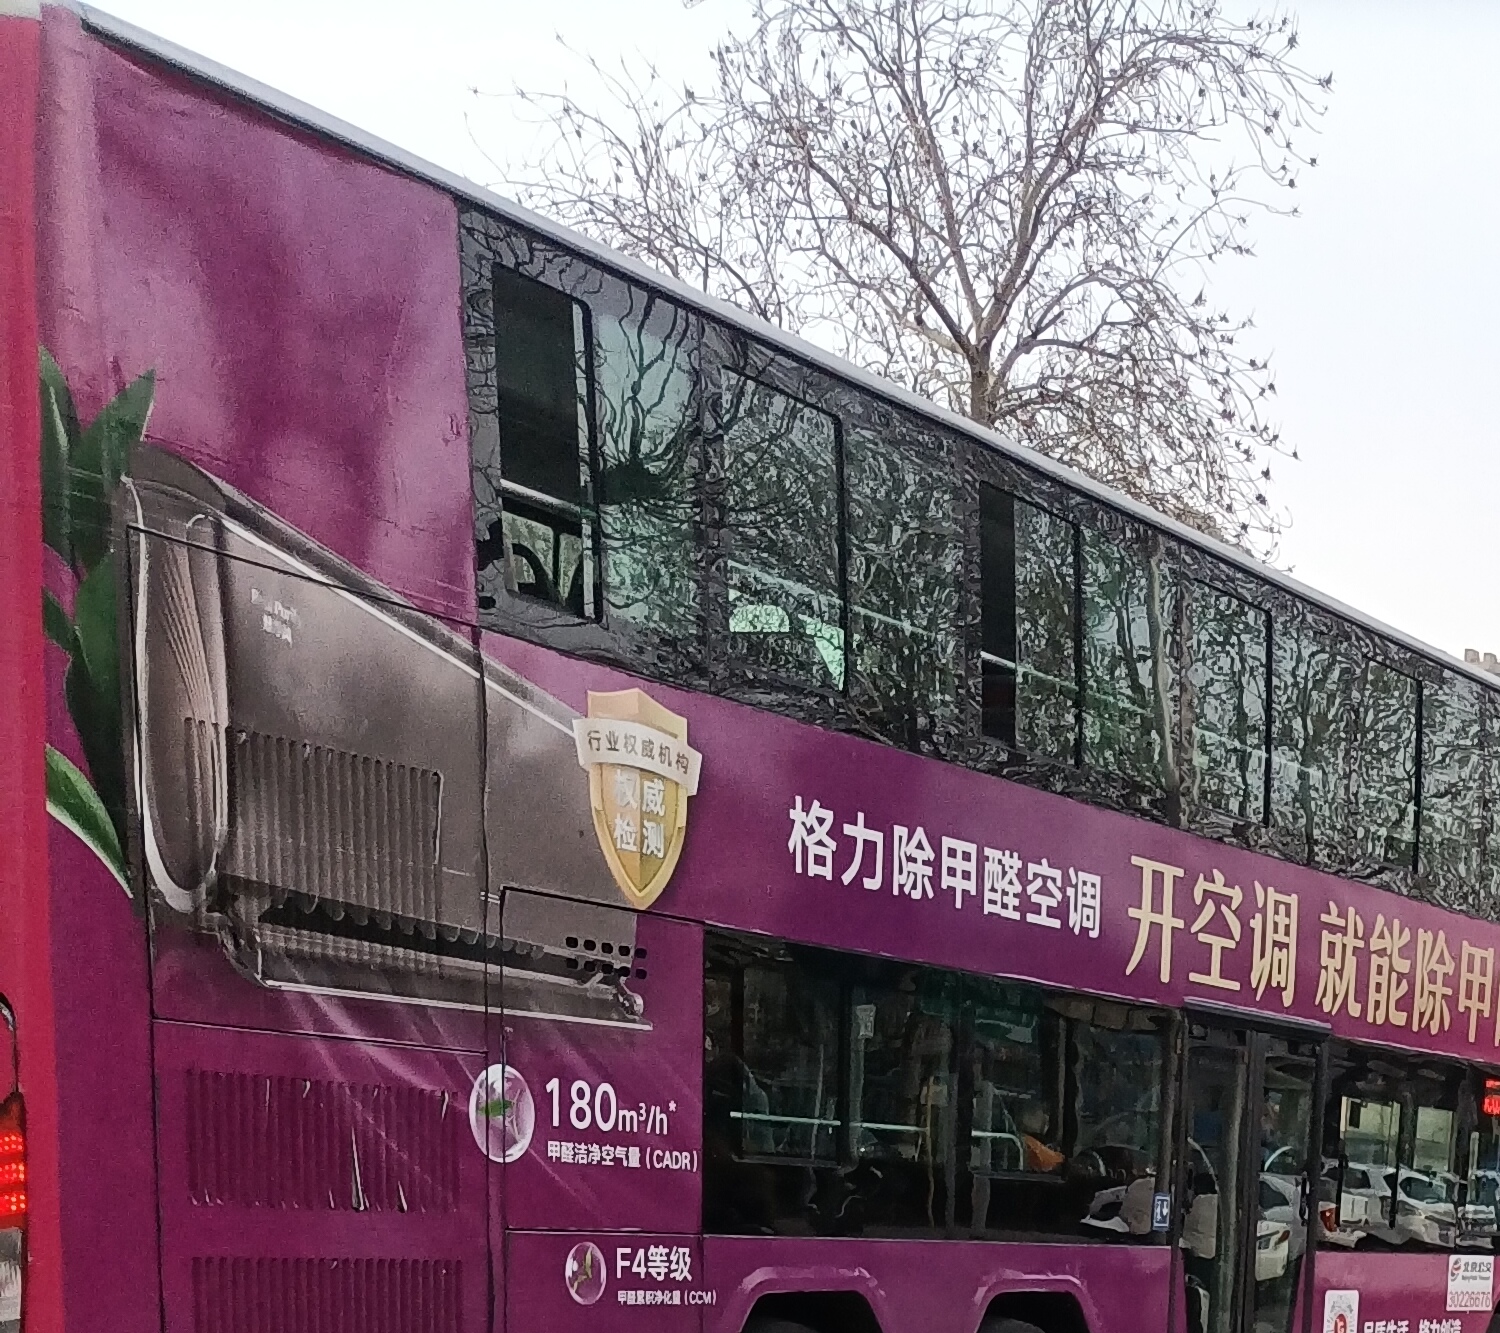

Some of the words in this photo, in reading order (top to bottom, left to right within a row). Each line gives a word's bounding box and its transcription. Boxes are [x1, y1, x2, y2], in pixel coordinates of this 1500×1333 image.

[586, 729, 690, 774] 行业权威机构
[614, 768, 666, 817] 权威
[613, 812, 665, 859] 检测
[787, 795, 1102, 939] 格力除甲醛空调
[1125, 854, 1299, 1008] 开空调
[616, 1244, 693, 1282] F4等级
